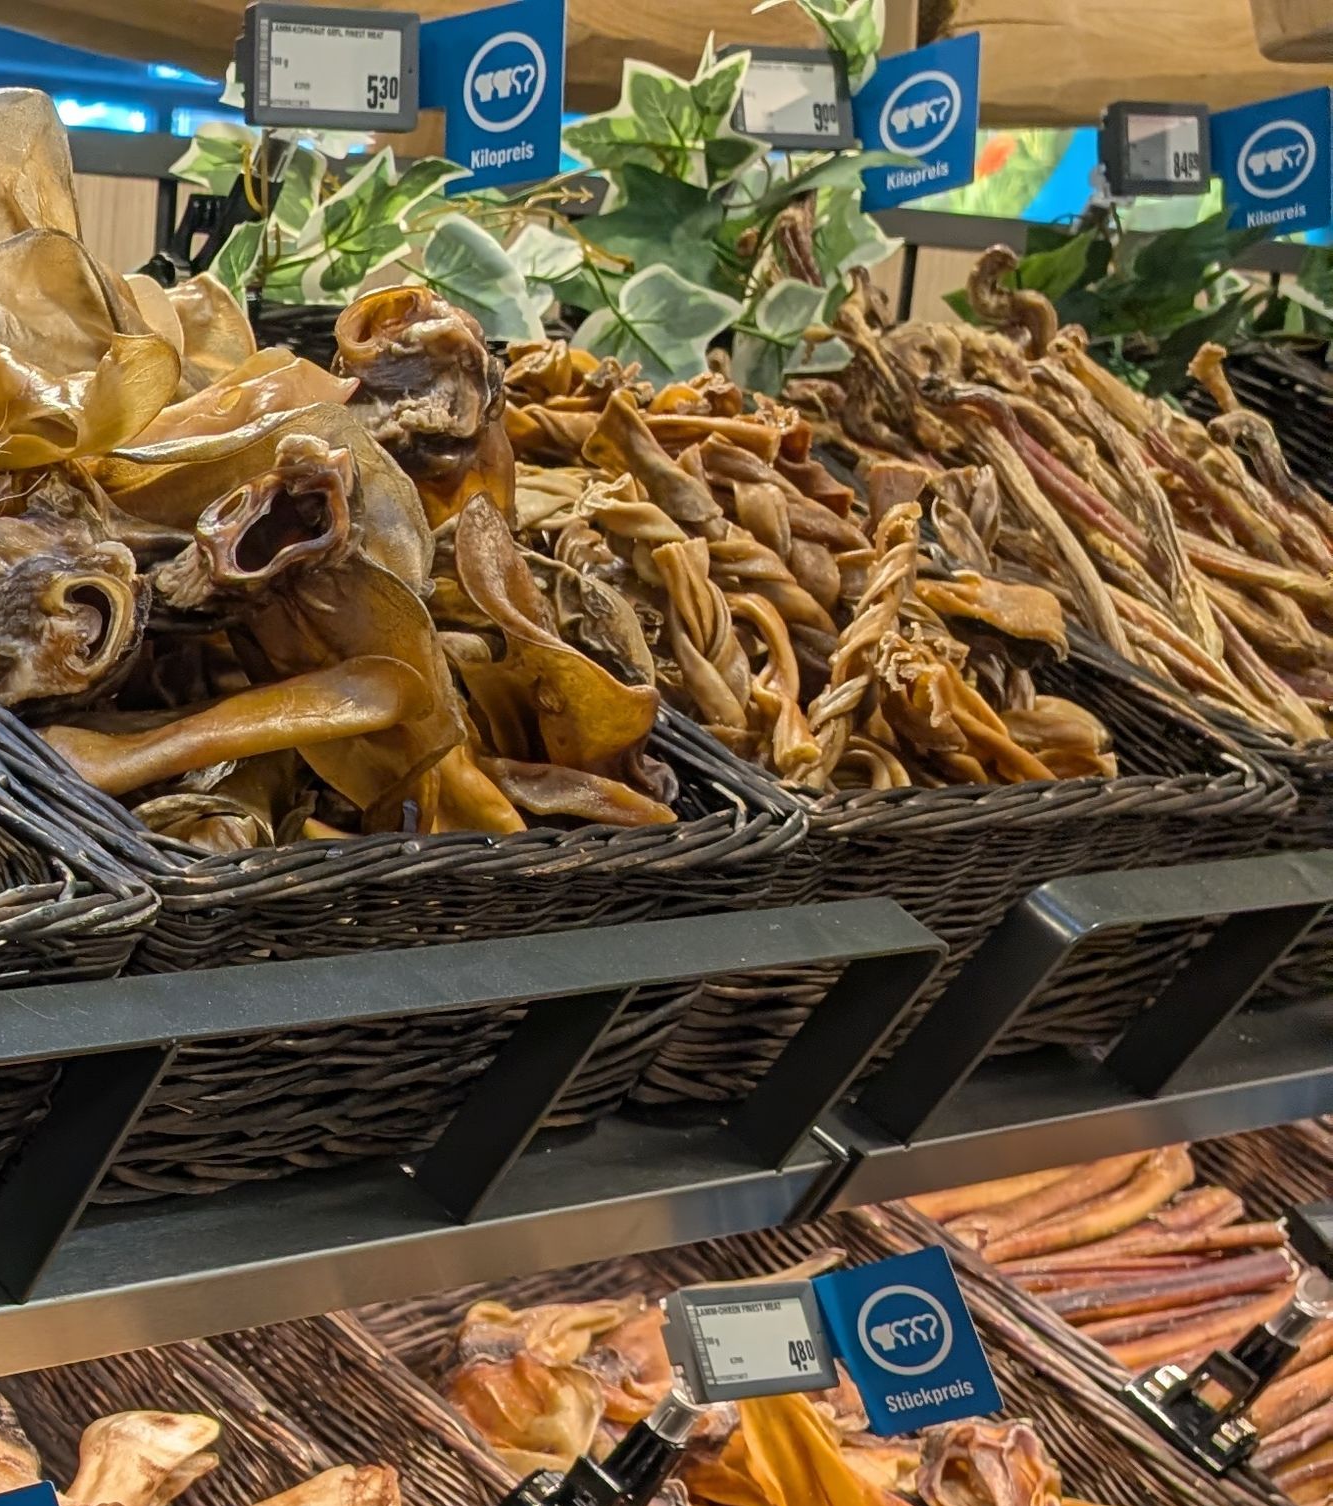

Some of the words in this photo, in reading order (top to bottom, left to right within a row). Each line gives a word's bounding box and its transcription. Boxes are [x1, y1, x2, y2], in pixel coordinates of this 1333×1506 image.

[367, 74, 399, 109] 5.30
[470, 141, 535, 170] Kilopreis
[886, 160, 950, 191] Kilopreis
[788, 1340, 816, 1372] 4.80
[885, 1379, 975, 1413] Stückpreis
